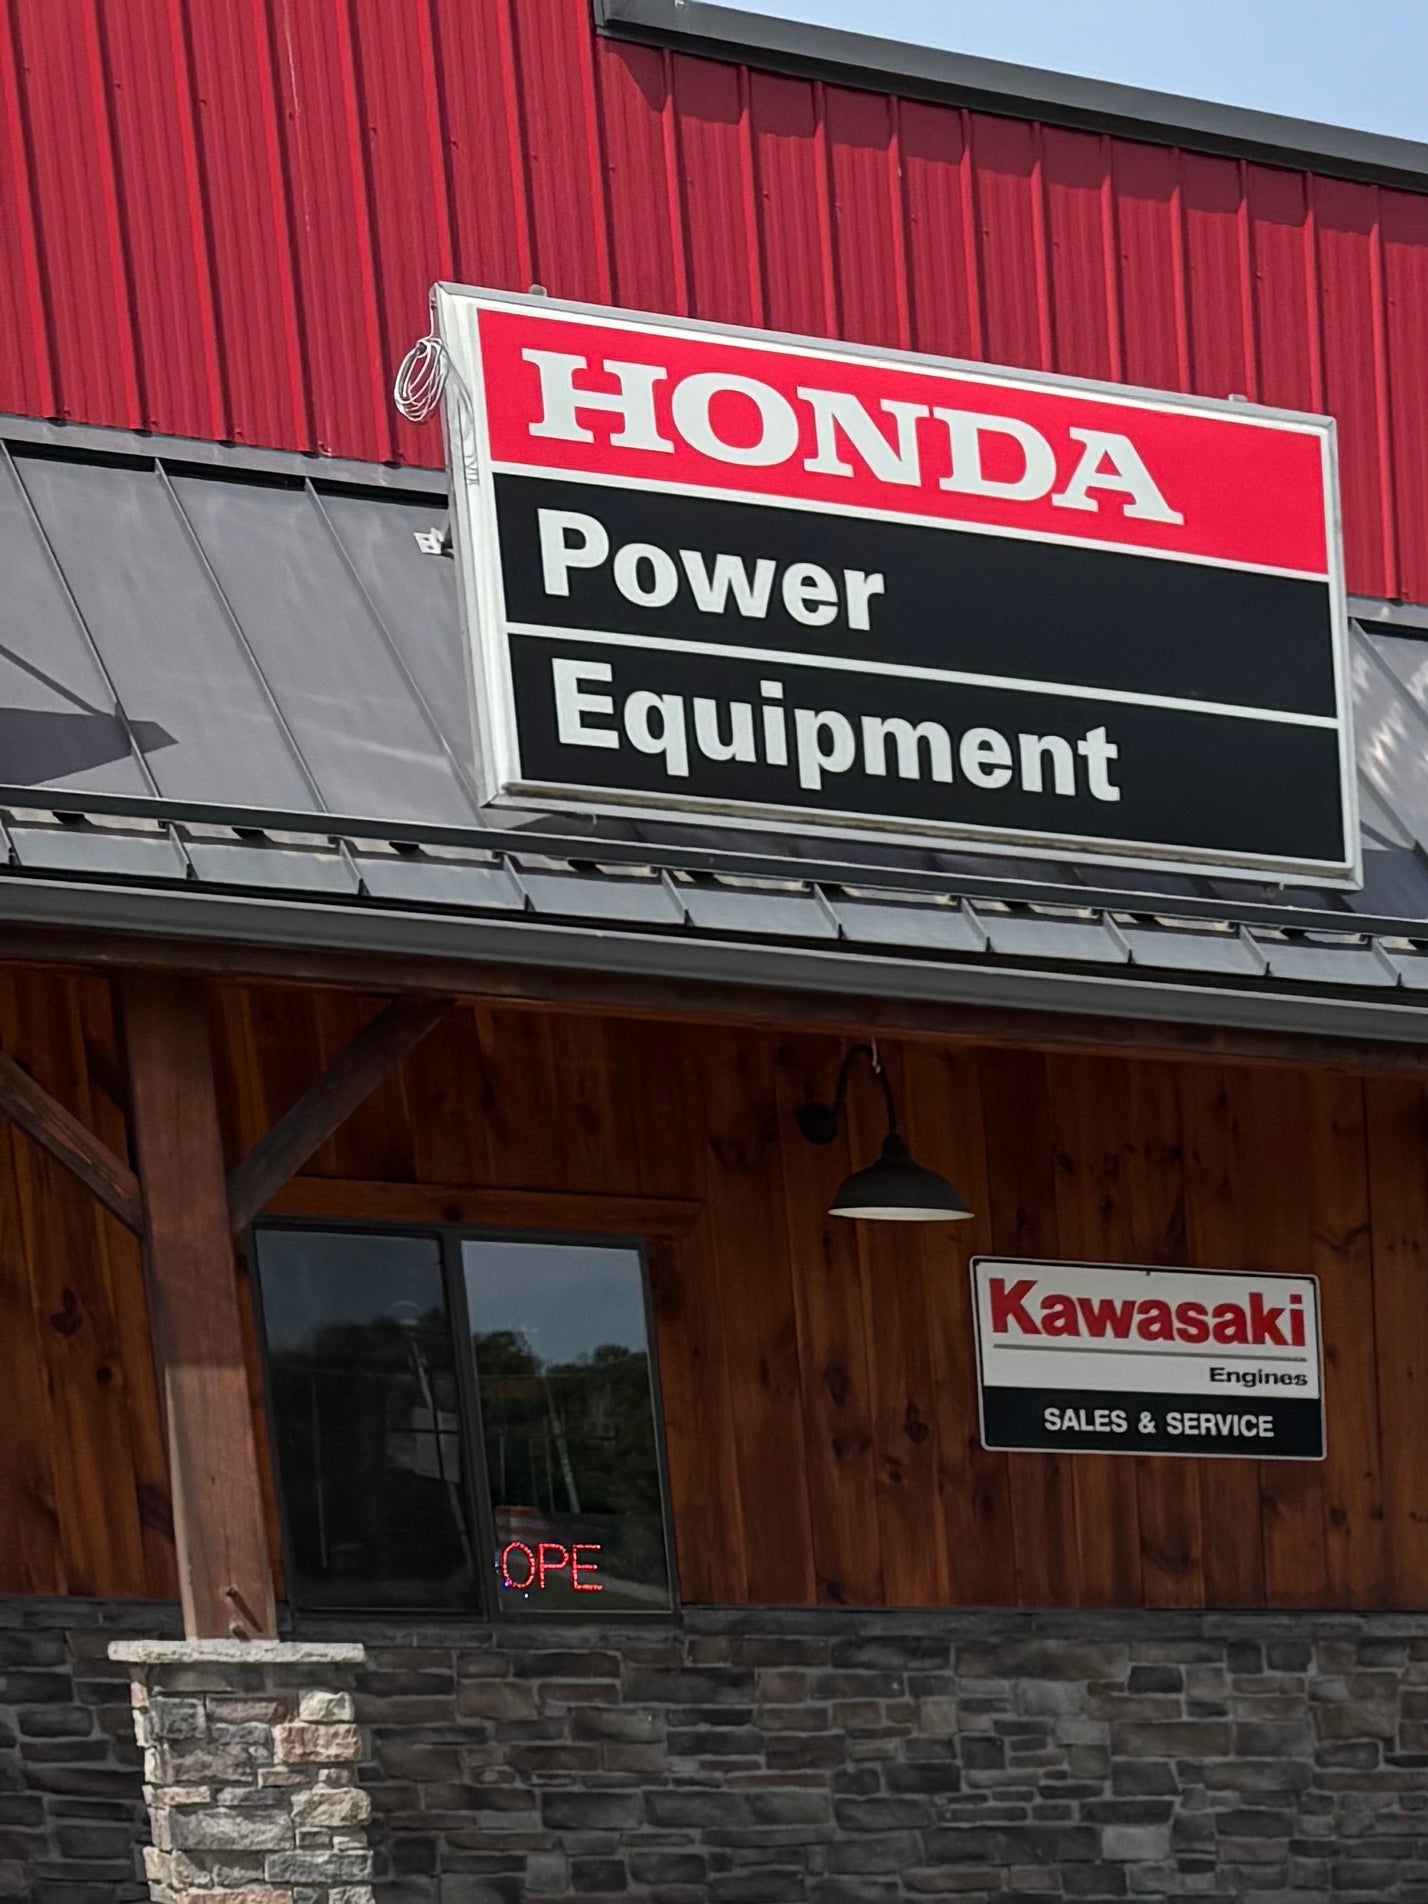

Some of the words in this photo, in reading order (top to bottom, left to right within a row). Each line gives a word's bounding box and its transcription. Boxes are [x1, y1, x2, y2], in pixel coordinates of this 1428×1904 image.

[521, 347, 1184, 526] HONDA
[537, 507, 885, 631] Power
[551, 658, 1121, 801] Equipment
[989, 1278, 1306, 1347] Kawasaki
[1209, 1367, 1308, 1387] Engines
[1044, 1407, 1128, 1433] SALES
[1138, 1413, 1156, 1434] &
[1166, 1412, 1275, 1438] SERVICE
[501, 1541, 602, 1591] OPE
